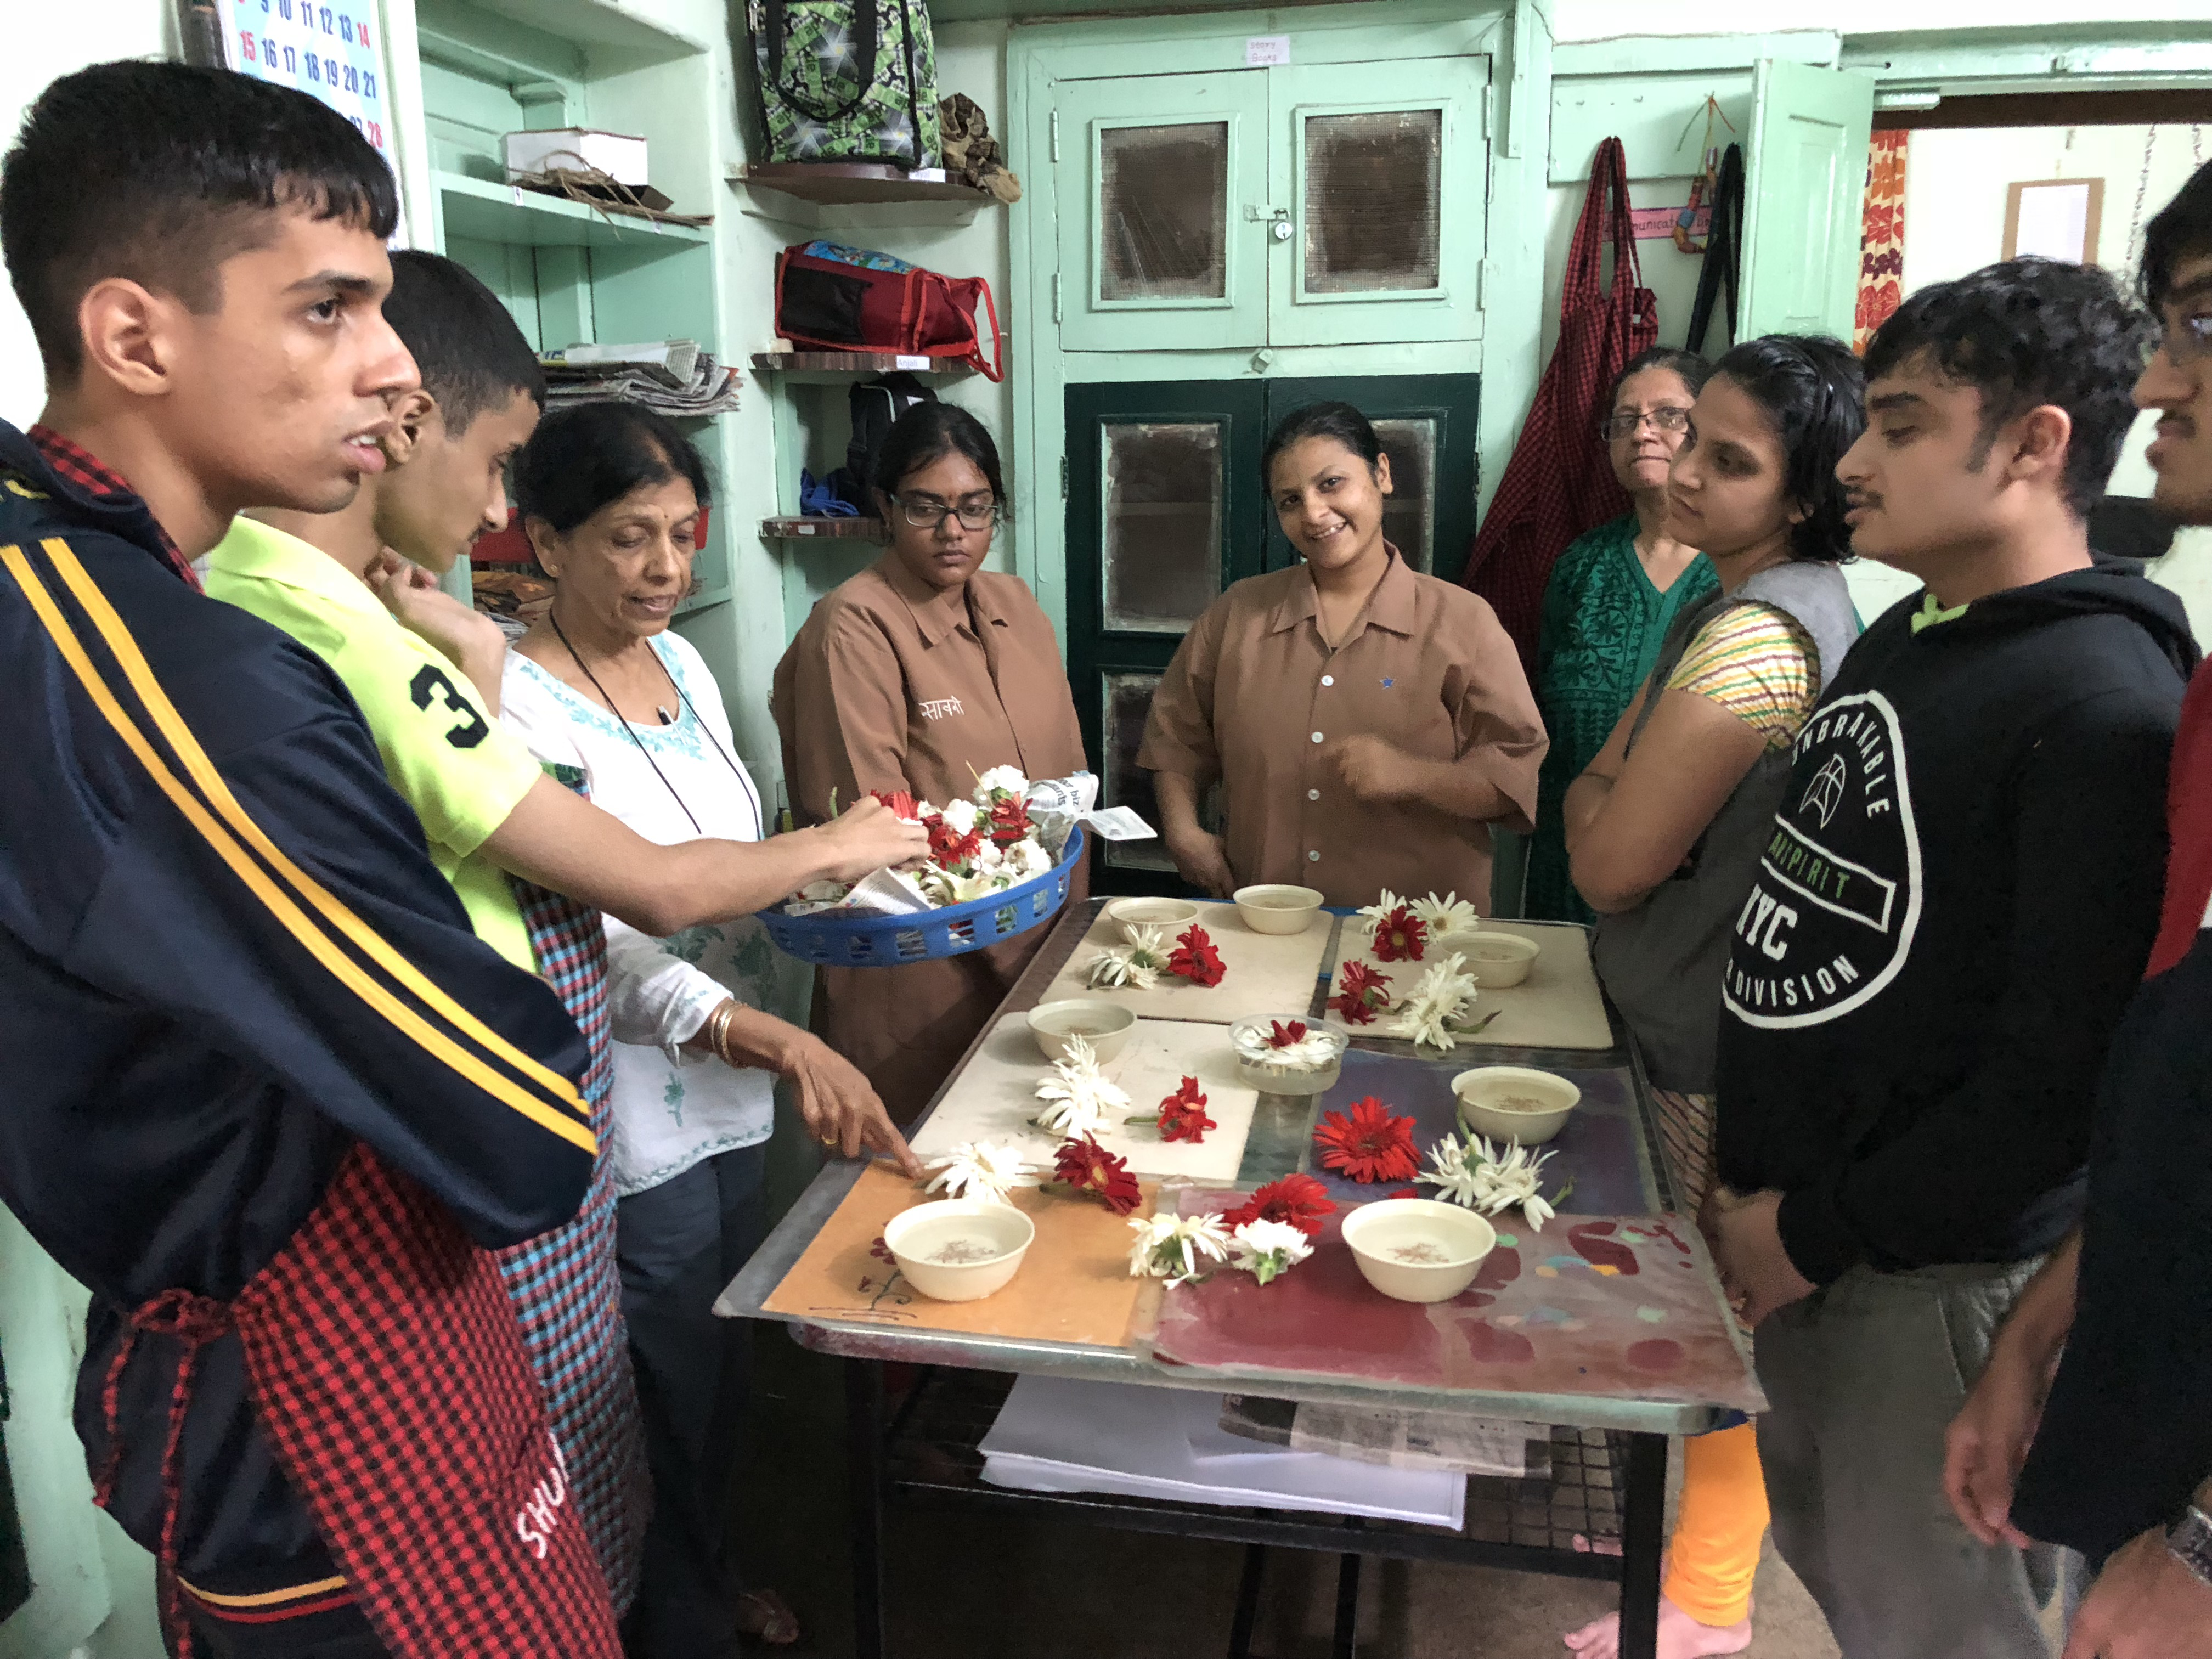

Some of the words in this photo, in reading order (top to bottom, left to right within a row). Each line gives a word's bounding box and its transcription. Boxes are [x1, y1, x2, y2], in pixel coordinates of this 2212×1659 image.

[279, 0, 292, 20] 10
[301, 1, 313, 29] 11
[319, 7, 334, 35] 12
[338, 14, 353, 43] 13
[357, 22, 370, 49] 14
[240, 30, 256, 61] 15
[262, 38, 277, 69] 16
[283, 45, 296, 74] 17
[304, 52, 320, 82] 18
[324, 59, 338, 87] 19
[343, 64, 359, 94] 20
[363, 70, 376, 99] 21
[368, 120, 383, 148] 28
[898, 358, 918, 370] Anjali
[410, 663, 490, 748] 3
[1735, 954, 1859, 1008] DIVISION
